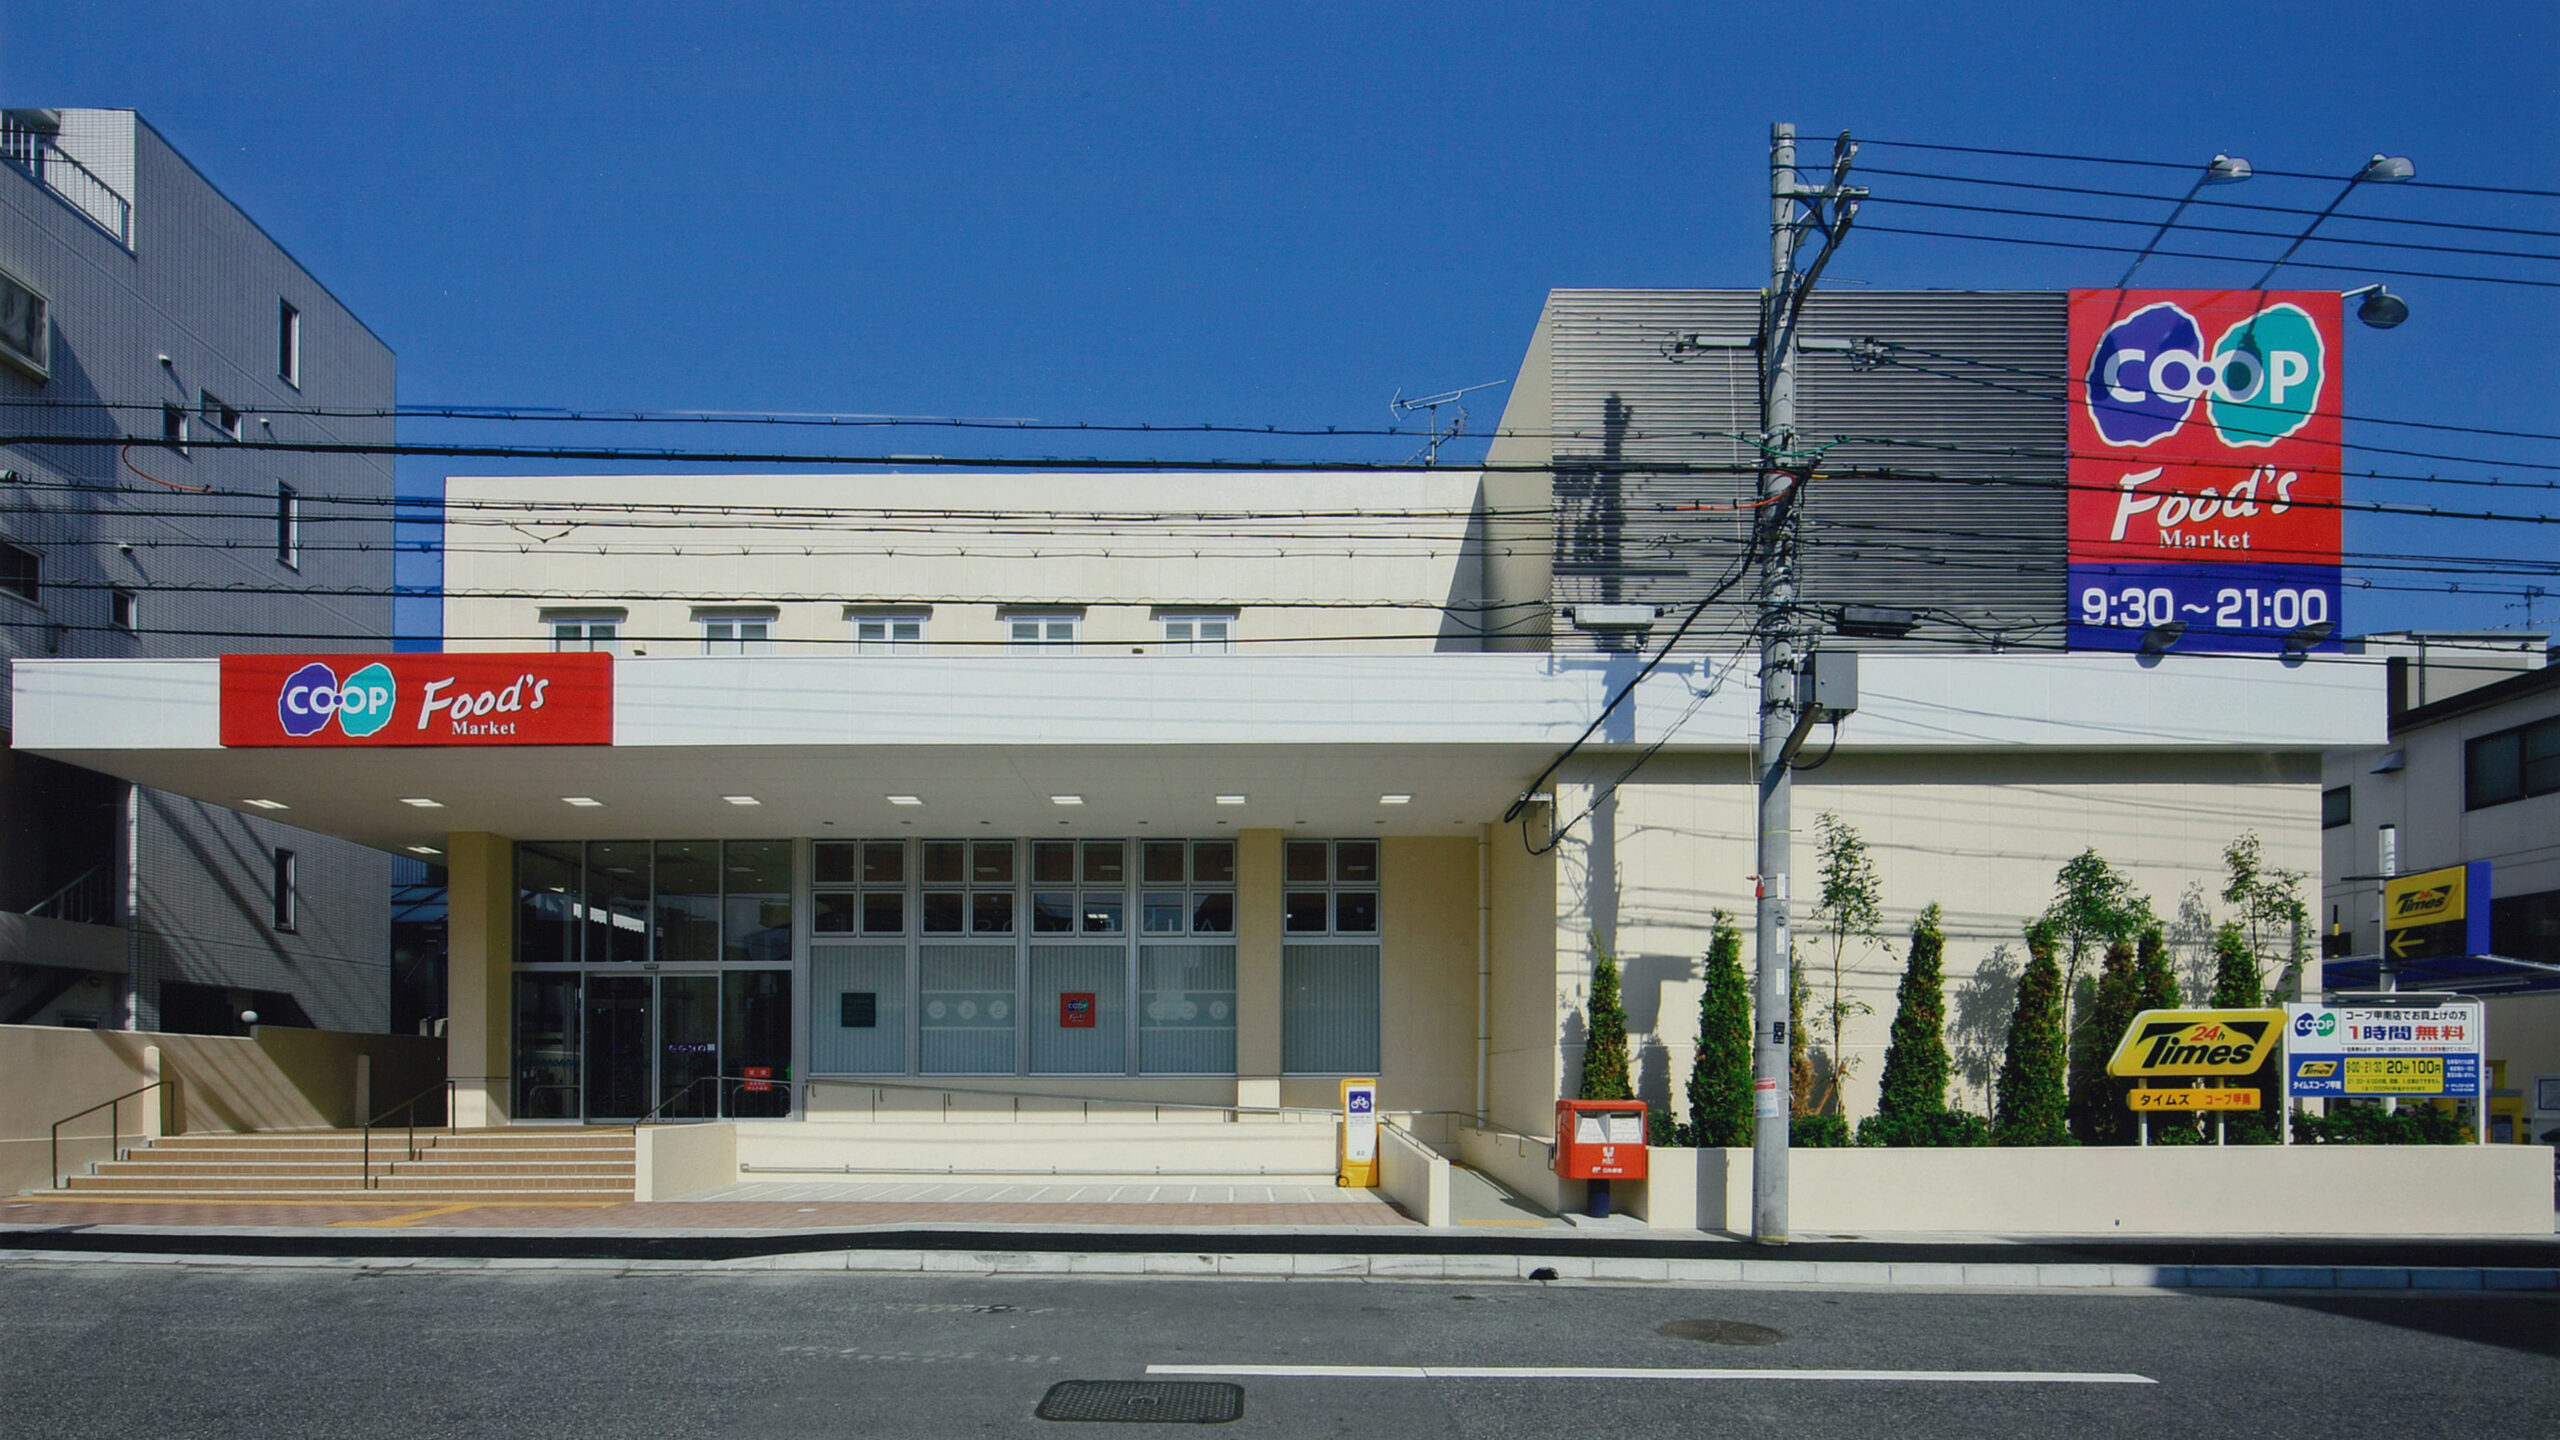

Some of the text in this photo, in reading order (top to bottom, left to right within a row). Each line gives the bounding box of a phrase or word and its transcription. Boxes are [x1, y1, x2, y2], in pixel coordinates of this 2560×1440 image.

[2110, 464, 2299, 541] Food's
[2159, 529, 2250, 549] Market
[417, 674, 549, 729] Food's
[452, 721, 515, 734] Market
[2141, 1036, 2254, 1068] Times
[2140, 1094, 2190, 1106] タイムズ
